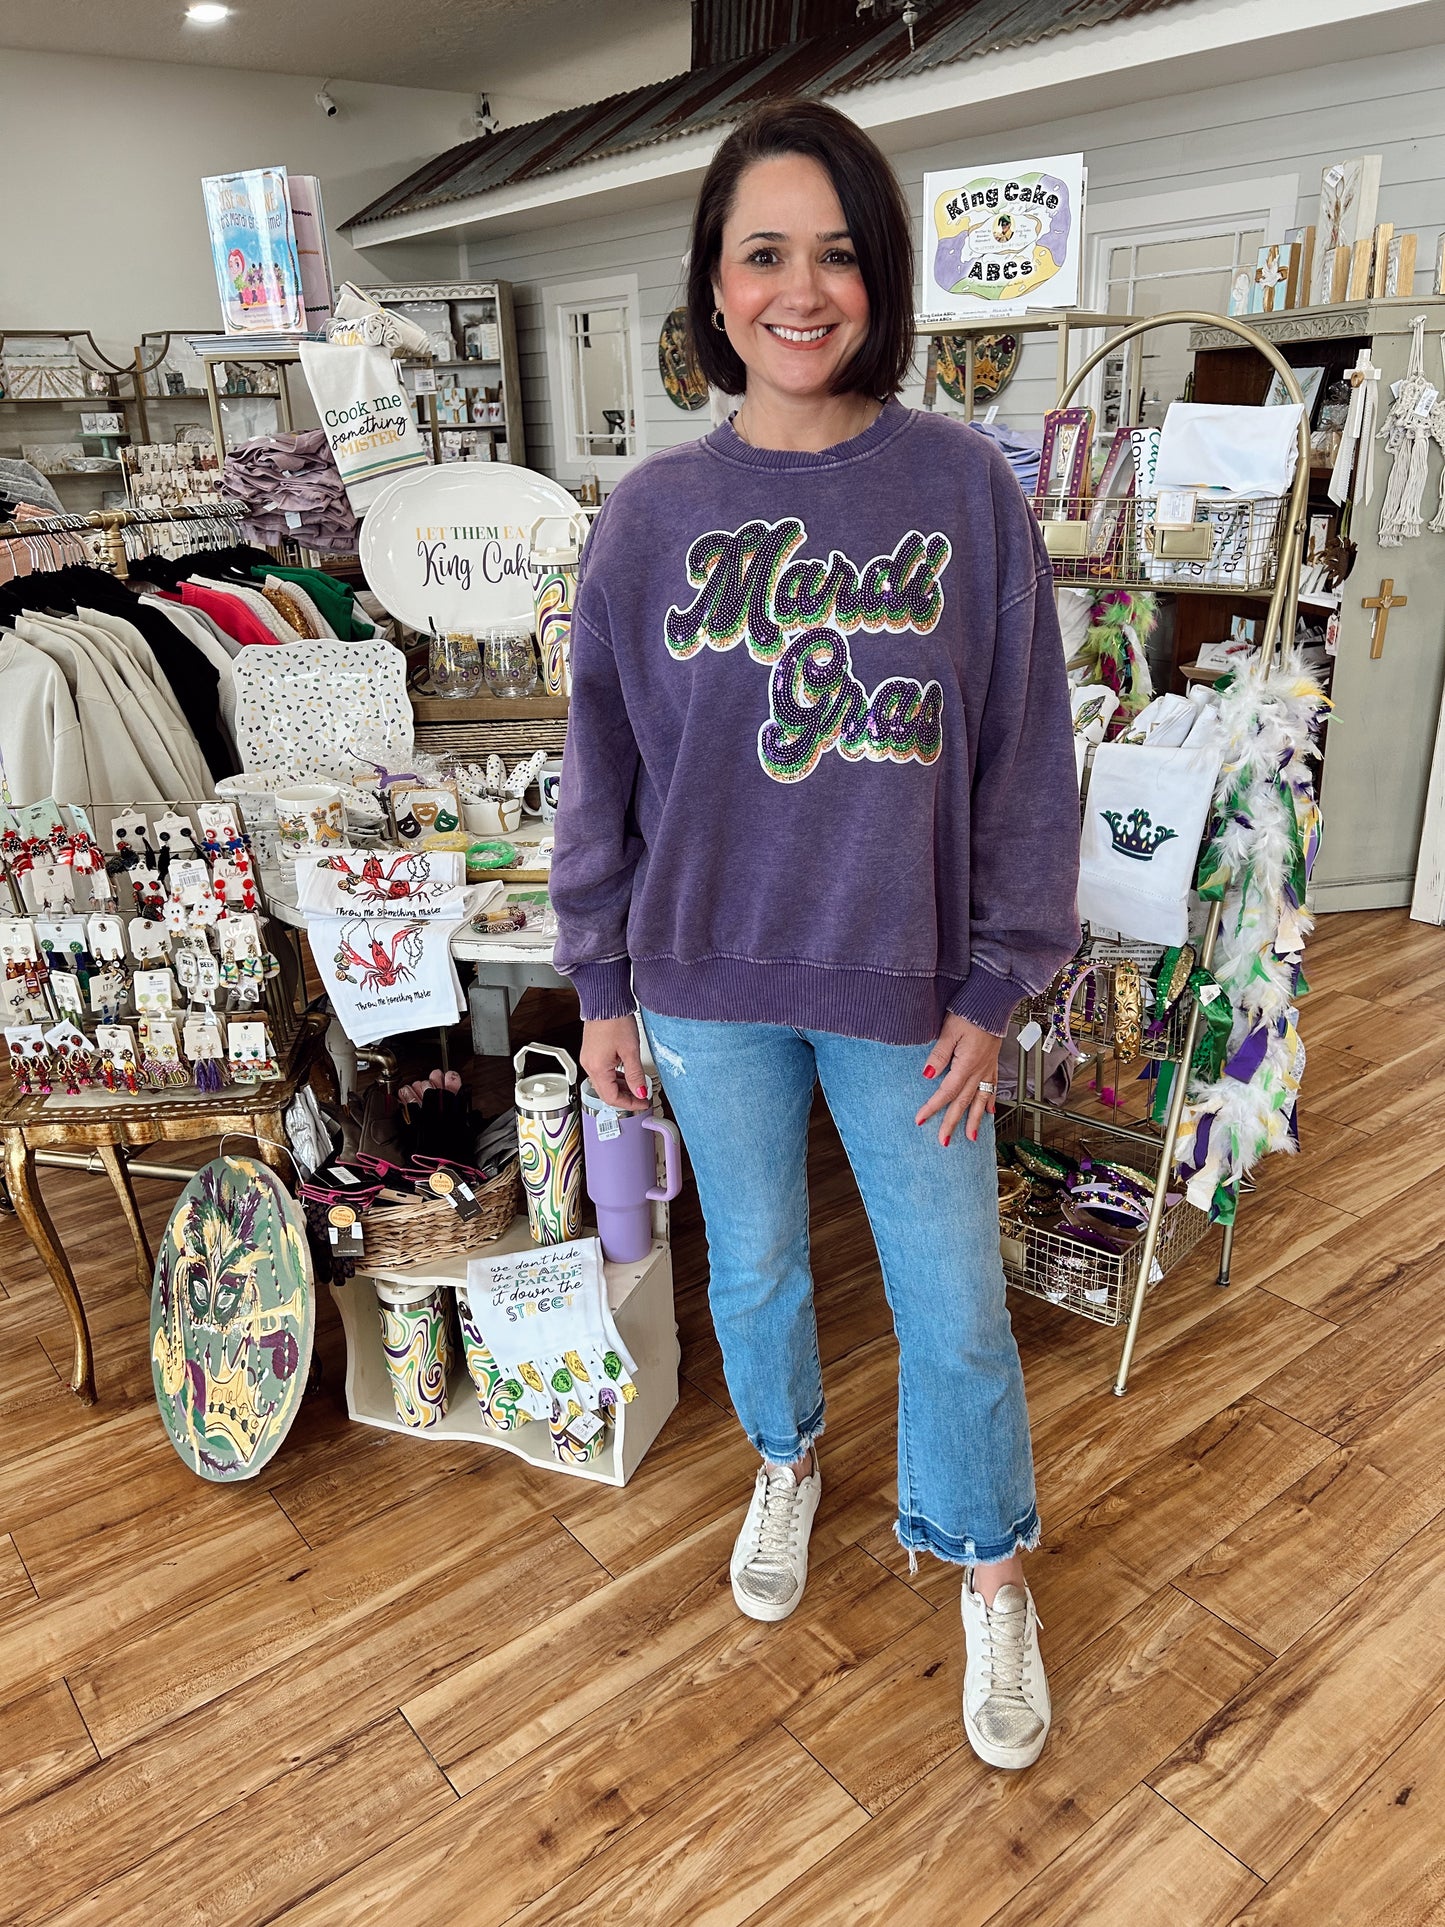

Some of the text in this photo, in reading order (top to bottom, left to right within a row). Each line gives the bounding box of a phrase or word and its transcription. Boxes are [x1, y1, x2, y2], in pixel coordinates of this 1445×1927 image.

[946, 182, 1059, 220] King Cake
[968, 261, 1033, 281] ABCs
[325, 394, 402, 427] Cook me
[332, 414, 408, 450] something
[339, 429, 401, 459] MISTER
[416, 526, 530, 540] LET THEM EA
[417, 540, 475, 590] King
[664, 518, 952, 664] Mardi
[758, 627, 943, 783] Gras
[335, 907, 362, 917] Throw
[364, 908, 374, 917] Me
[377, 907, 416, 918] Something
[355, 1001, 377, 1011] Throw
[377, 998, 386, 1006] Me
[552, 1247, 581, 1263] hide
[490, 1267, 582, 1292] we PARADE
[491, 1273, 514, 1283] the
[492, 1279, 584, 1307] it down the
[505, 1293, 575, 1323] STREET
